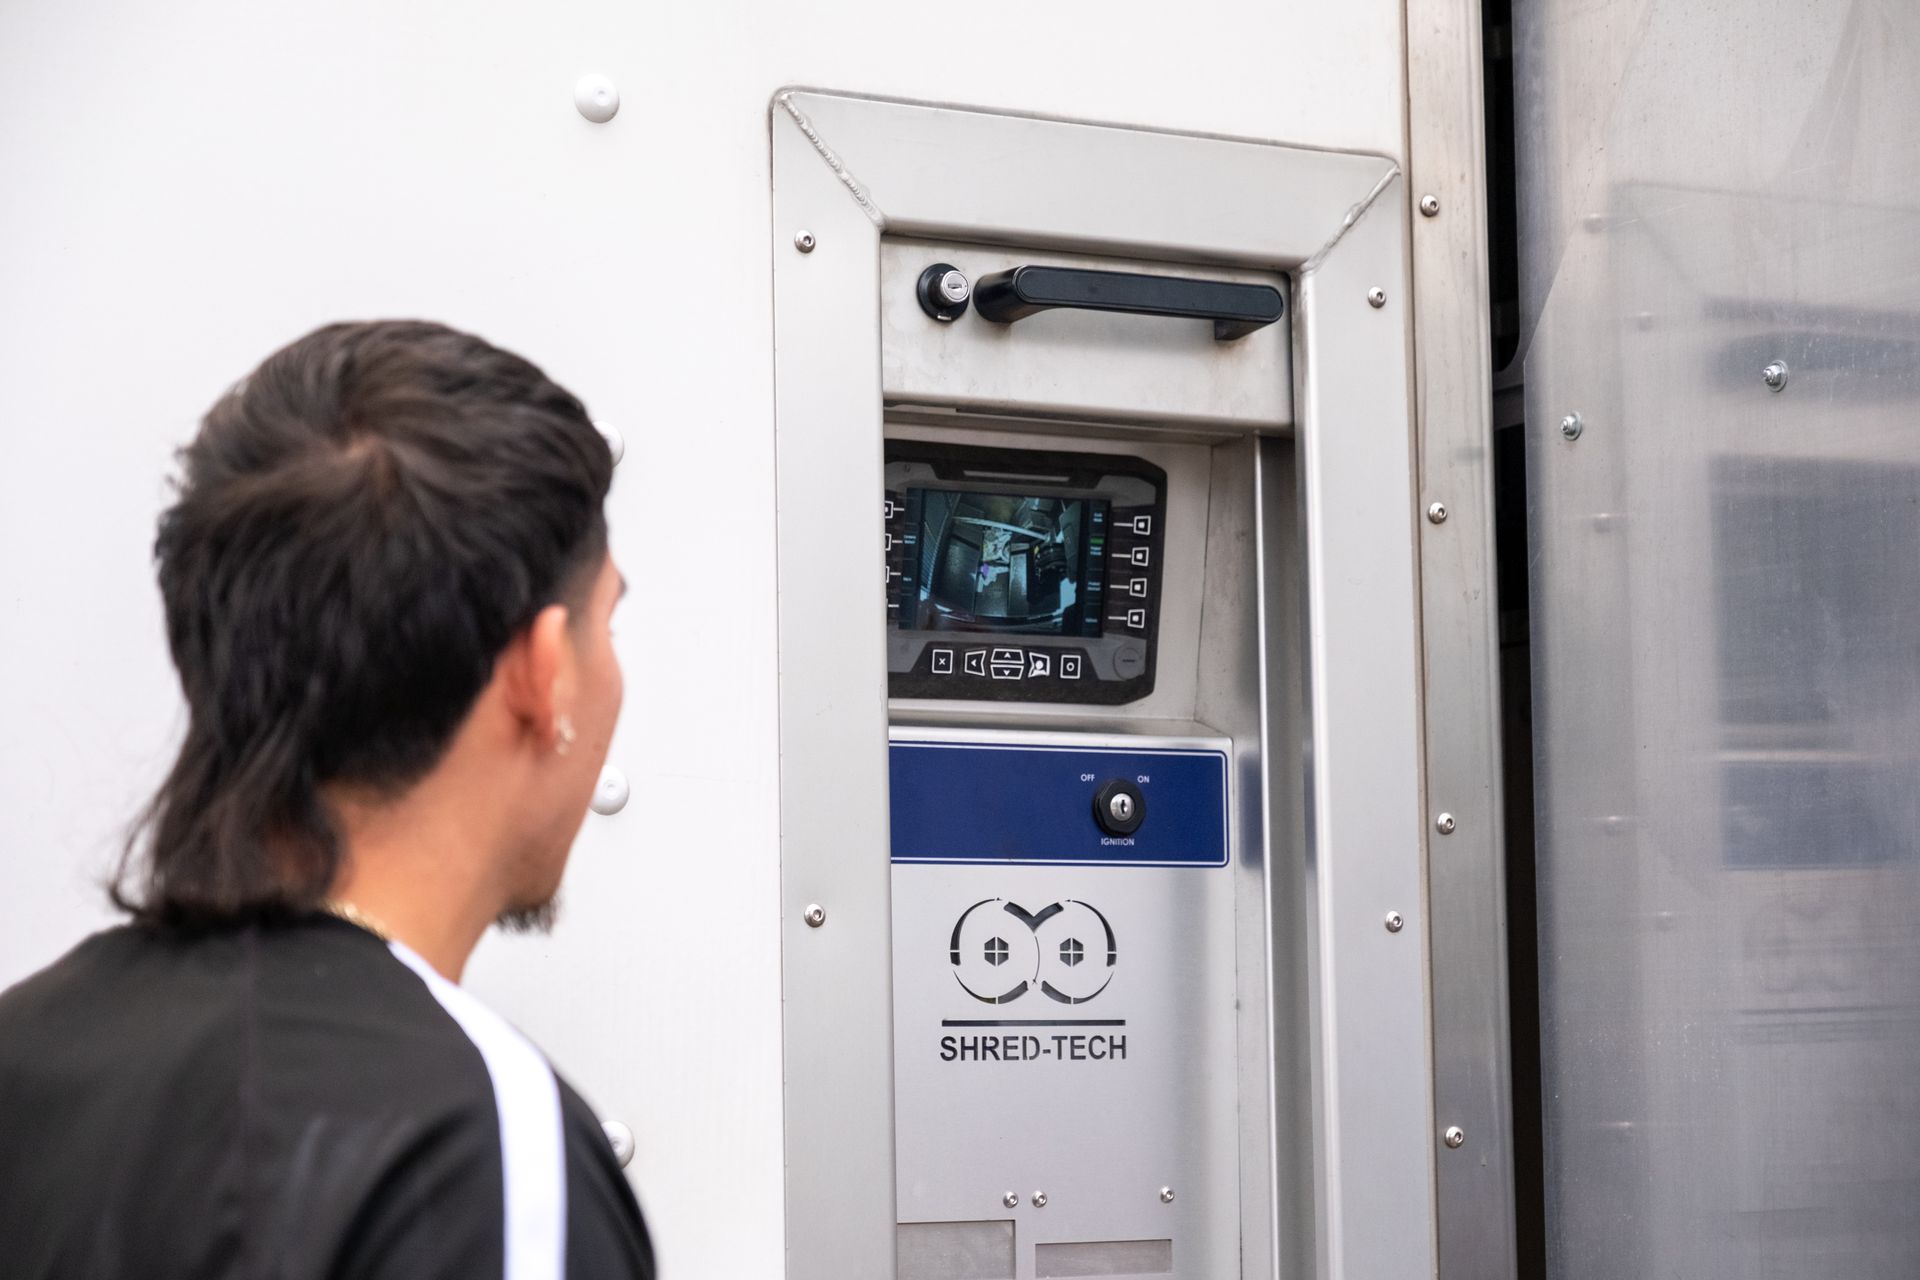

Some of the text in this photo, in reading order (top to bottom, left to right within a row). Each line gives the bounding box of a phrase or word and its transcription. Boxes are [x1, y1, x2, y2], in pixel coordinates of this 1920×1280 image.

[1080, 774, 1095, 782] OFF
[1137, 775, 1150, 783] ON
[1101, 838, 1135, 846] IGNITION
[940, 1035, 1127, 1061] SHRED-TECH
